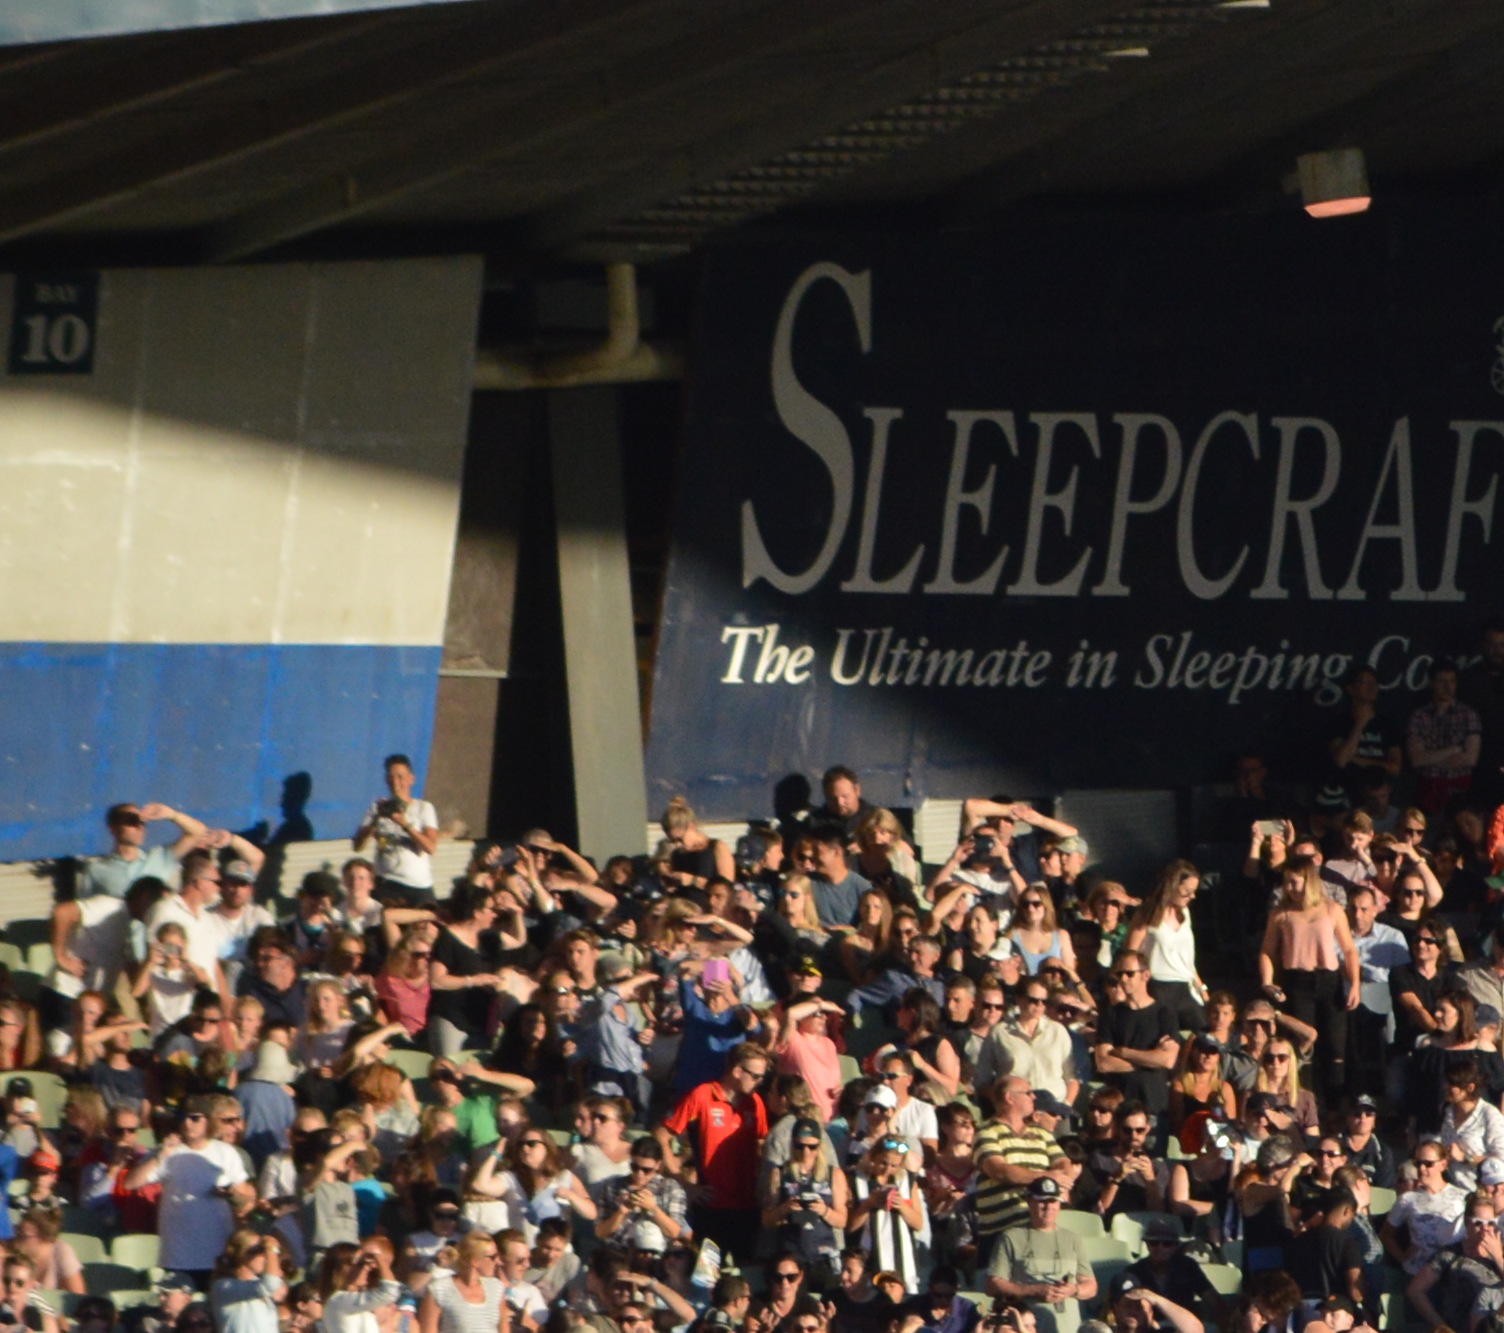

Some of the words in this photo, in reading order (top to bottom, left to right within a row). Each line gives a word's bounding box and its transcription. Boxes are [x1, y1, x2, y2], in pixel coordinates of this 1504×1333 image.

[20, 313, 90, 363] 10
[721, 623, 812, 685] The
[829, 629, 1053, 688] Ultimate
[1067, 636, 1116, 688] in
[1135, 631, 1353, 704] Sleeping
